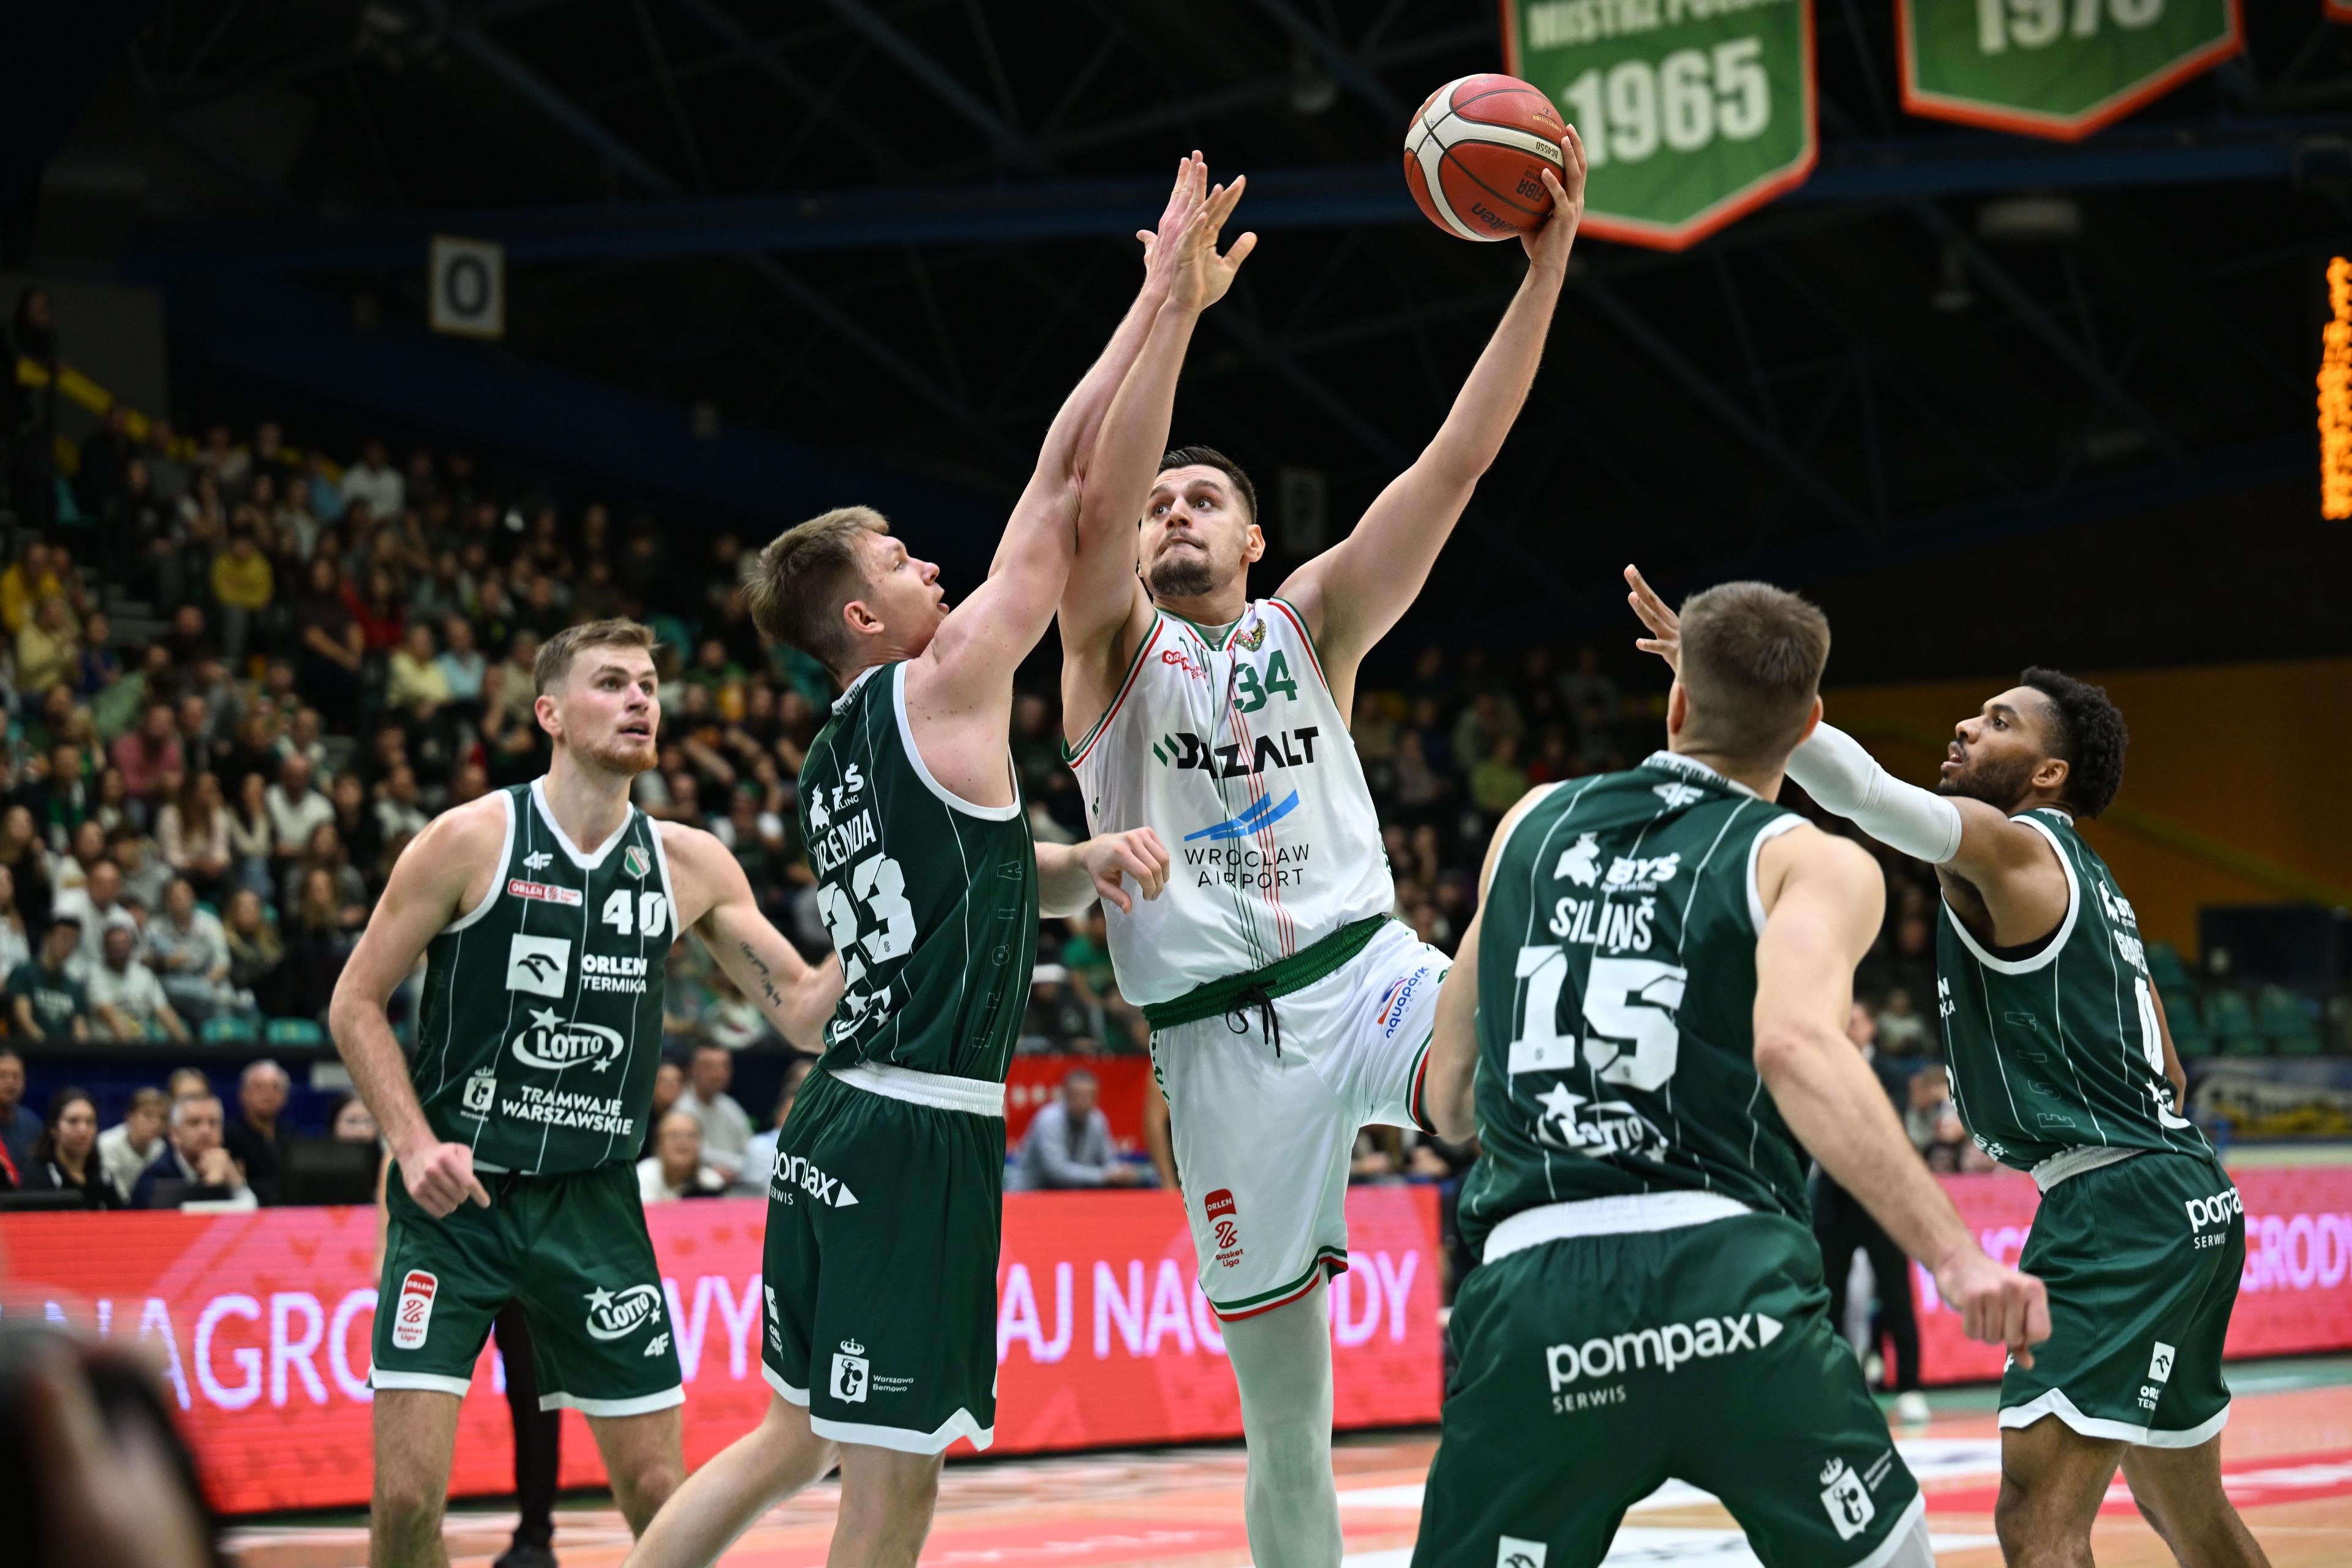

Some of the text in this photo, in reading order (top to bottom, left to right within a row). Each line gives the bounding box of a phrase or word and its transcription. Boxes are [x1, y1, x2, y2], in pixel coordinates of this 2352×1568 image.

[1563, 38, 1771, 165] 1965
[1536, 141, 1559, 159] BG4550
[1516, 178, 1547, 202] FIBA
[1232, 649, 1298, 714] 34
[1175, 726, 1319, 779] BAZALT
[1185, 844, 1308, 867] WROCLAW
[511, 883, 543, 897] ORLEN
[1198, 869, 1303, 889] AIRPORT
[602, 889, 668, 938] 40
[817, 851, 917, 991] 23
[582, 954, 648, 976] ORLEN
[581, 974, 647, 993] TERMIKA
[1385, 965, 1430, 1039] aquapark
[1507, 945, 1689, 1092] 15
[537, 1029, 603, 1060] LOTTO
[521, 1085, 623, 1117] TRAMWAJE
[501, 1099, 633, 1135] WARSZAWSKIE
[1558, 1115, 1644, 1150] LOTTO
[1207, 1197, 1232, 1212] ORLEN
[1216, 1248, 1244, 1261] Basket
[2194, 1232, 2225, 1250] SERWIS
[1223, 1258, 1240, 1268] Liga
[407, 1279, 433, 1291] ORLEN
[599, 1292, 649, 1330] LOTTO
[1546, 1313, 1756, 1393] pompax
[873, 1374, 914, 1384] Warszawa
[1552, 1384, 1627, 1414] SERWIS
